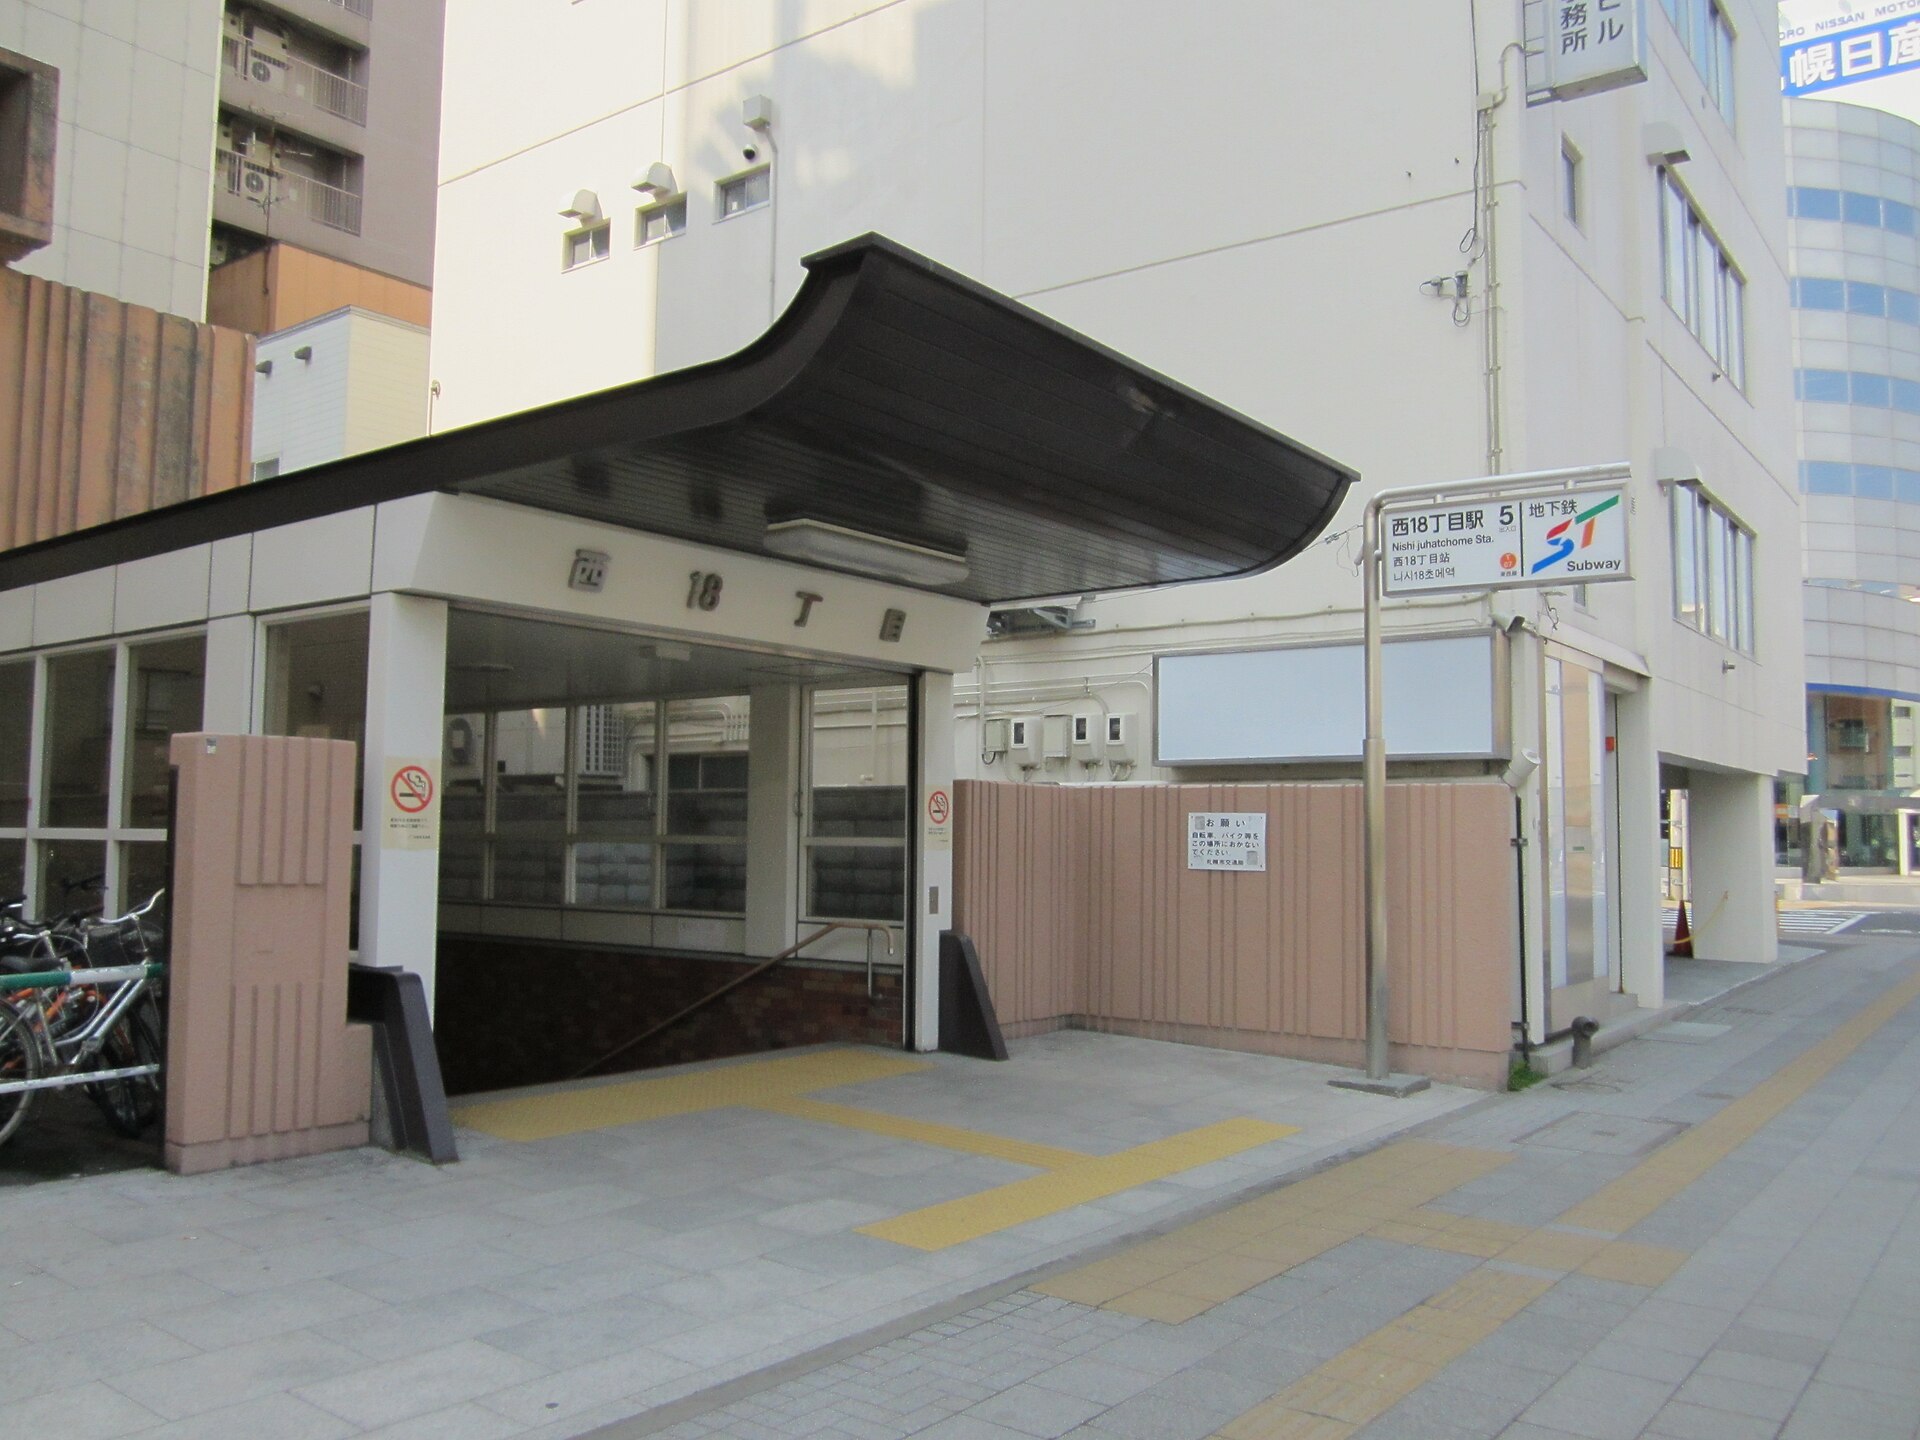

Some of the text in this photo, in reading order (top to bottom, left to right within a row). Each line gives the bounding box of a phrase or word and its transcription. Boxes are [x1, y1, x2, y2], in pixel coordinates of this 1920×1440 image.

[1561, 0, 1588, 55] 務所
[1815, 12, 1865, 32] NISSAN
[1781, 21, 1920, 91] 幌日産
[1499, 505, 1514, 526] 5
[1529, 499, 1578, 518] 地下鉄
[1391, 509, 1485, 537] 西18丁目駅
[1392, 534, 1494, 552] Nishi juhatchome Sta.
[1393, 552, 1450, 567] 西18丁目站
[1567, 559, 1621, 571] Subway
